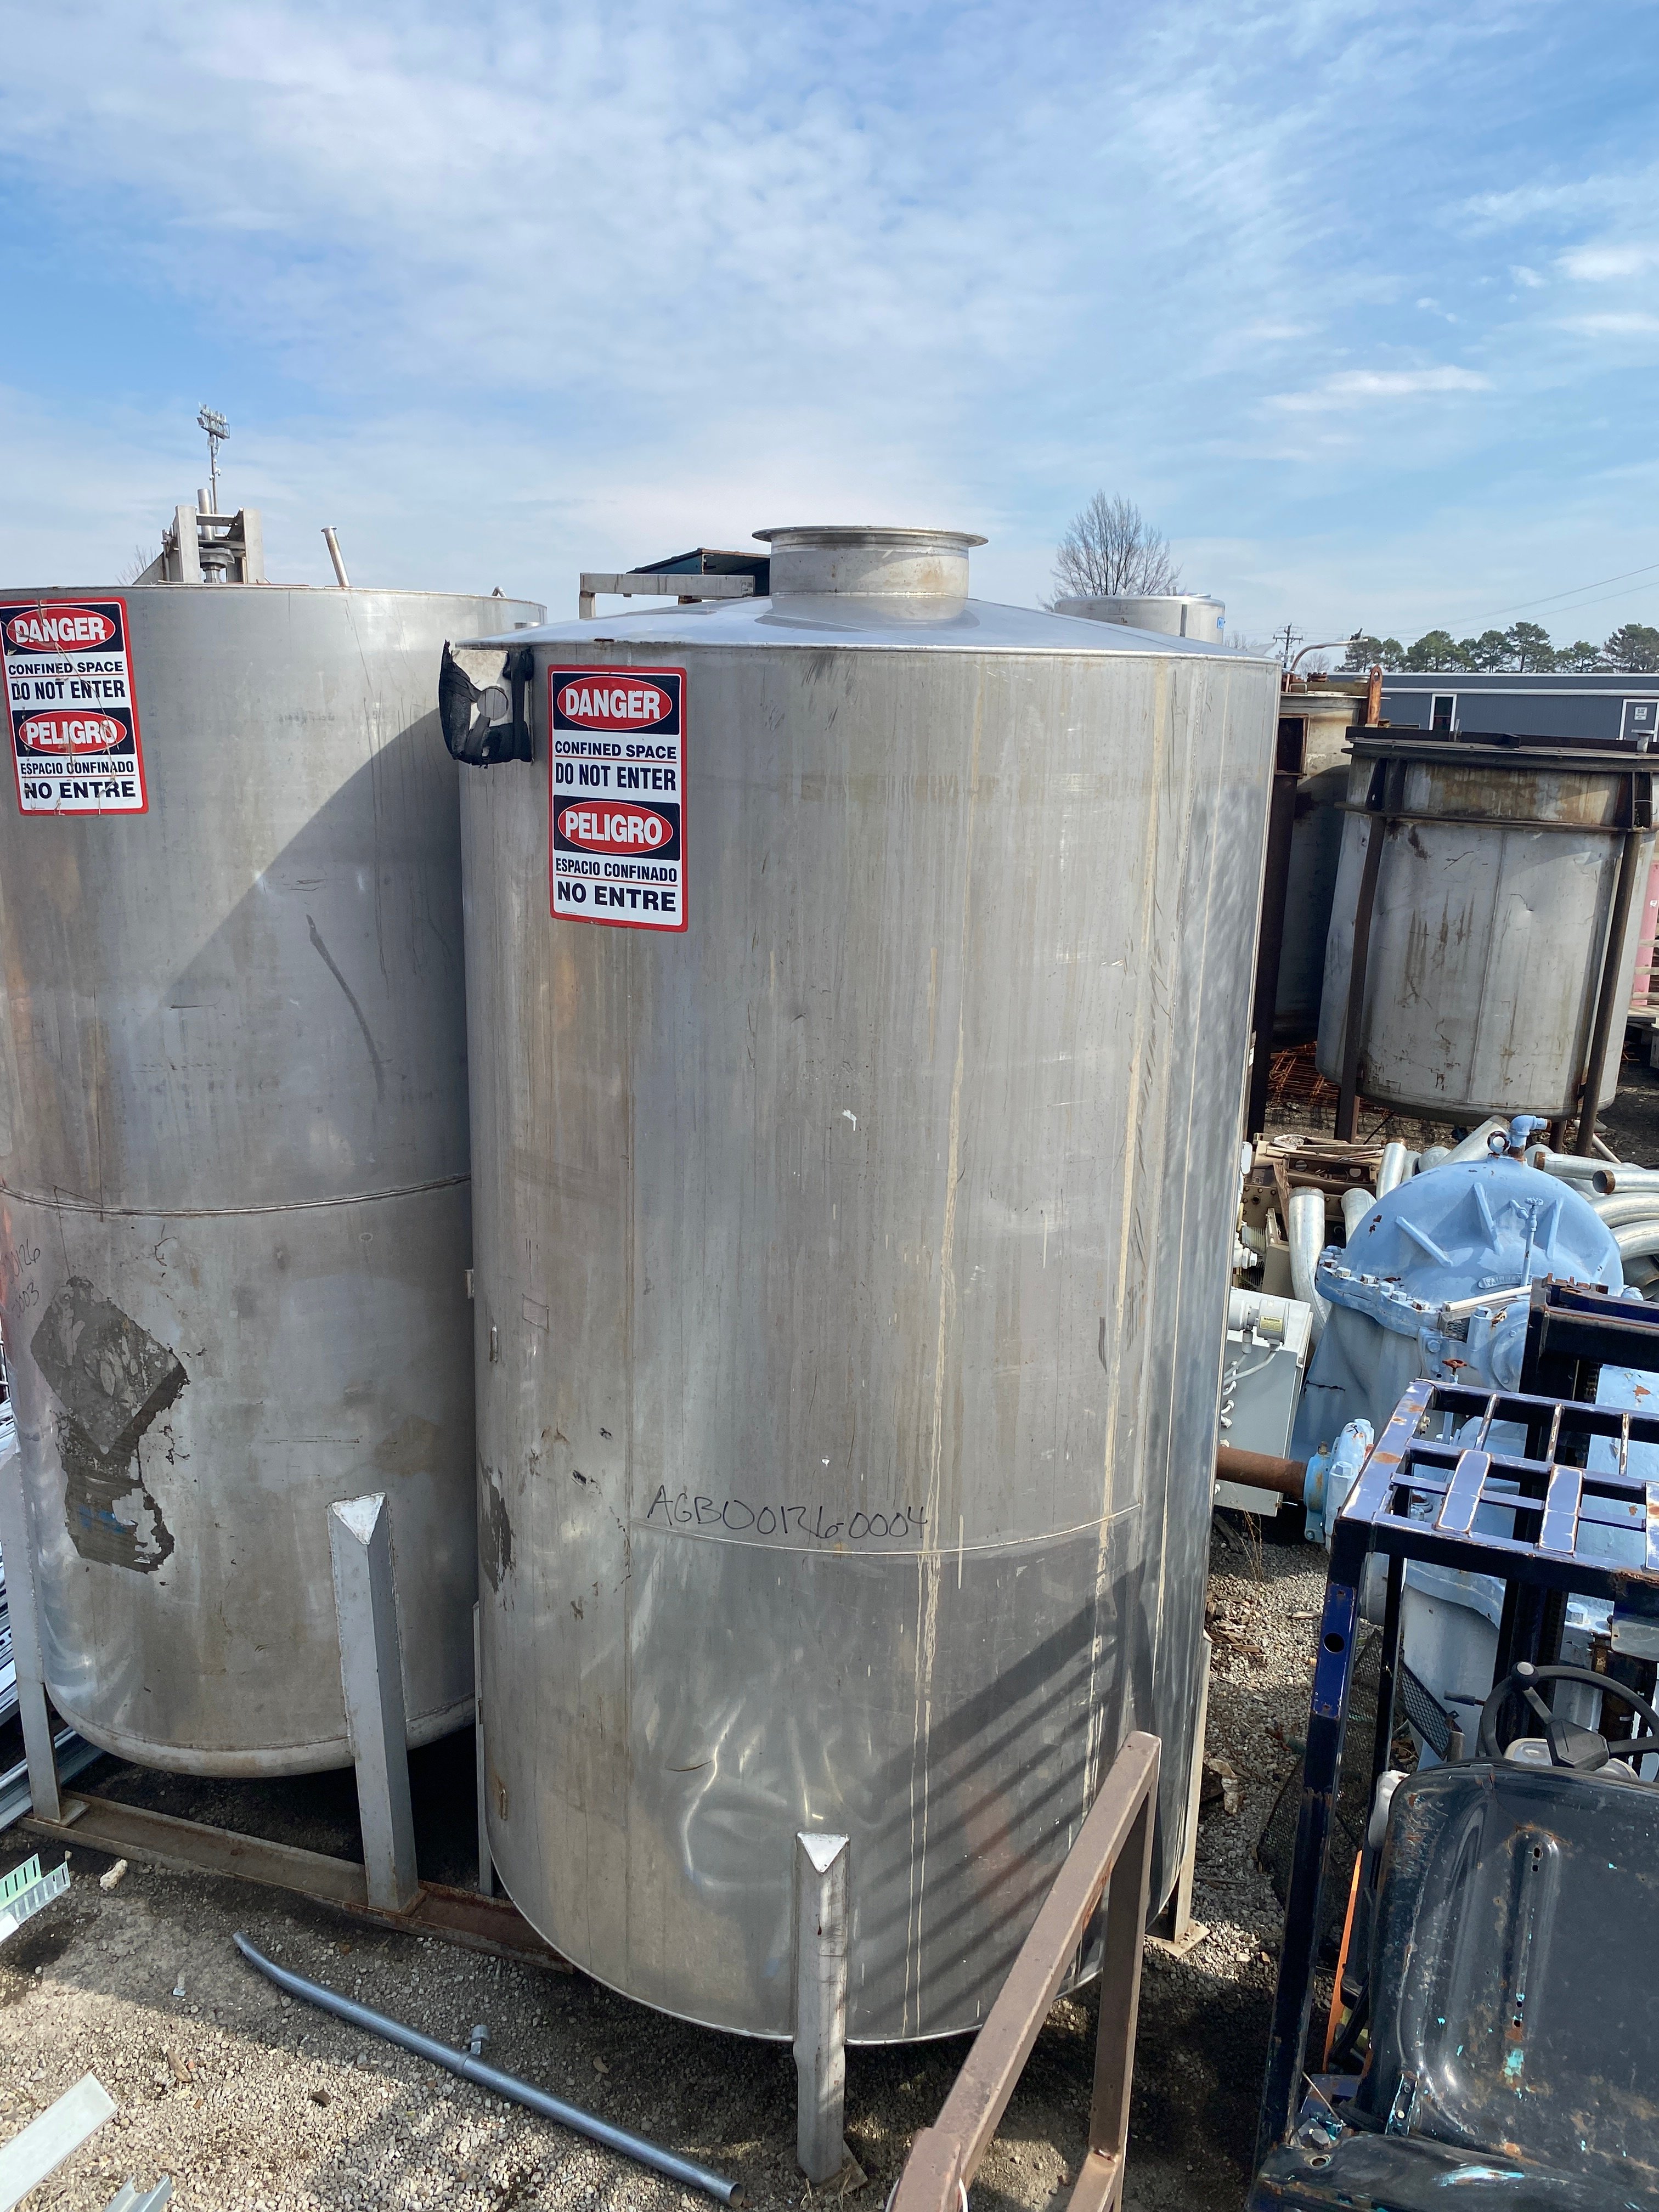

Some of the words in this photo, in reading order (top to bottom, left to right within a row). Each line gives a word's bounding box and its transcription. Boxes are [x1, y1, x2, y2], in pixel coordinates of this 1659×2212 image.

[14, 617, 106, 643] DANGER
[9, 663, 73, 675] CONFINED
[77, 662, 123, 673] SPACE
[12, 681, 30, 700] DO
[35, 681, 65, 699] NOT
[70, 680, 126, 699] ENTER
[566, 689, 660, 719] DANGER
[26, 720, 117, 745] PELIGRO
[555, 741, 621, 756] CONFINED
[626, 744, 676, 759] SPACE
[21, 762, 63, 774] ESPACIO
[67, 761, 134, 774] CONFINADO
[556, 763, 573, 785] DO
[579, 764, 611, 787] NOT
[617, 766, 676, 791] ENTER
[24, 782, 52, 799] NO
[59, 781, 136, 799] ENTRE
[565, 811, 663, 845] PELIGRO
[556, 857, 600, 876] ESPACIO
[605, 862, 677, 882] CONFINADO
[557, 881, 586, 904] NO
[595, 885, 676, 912] ENTRE
